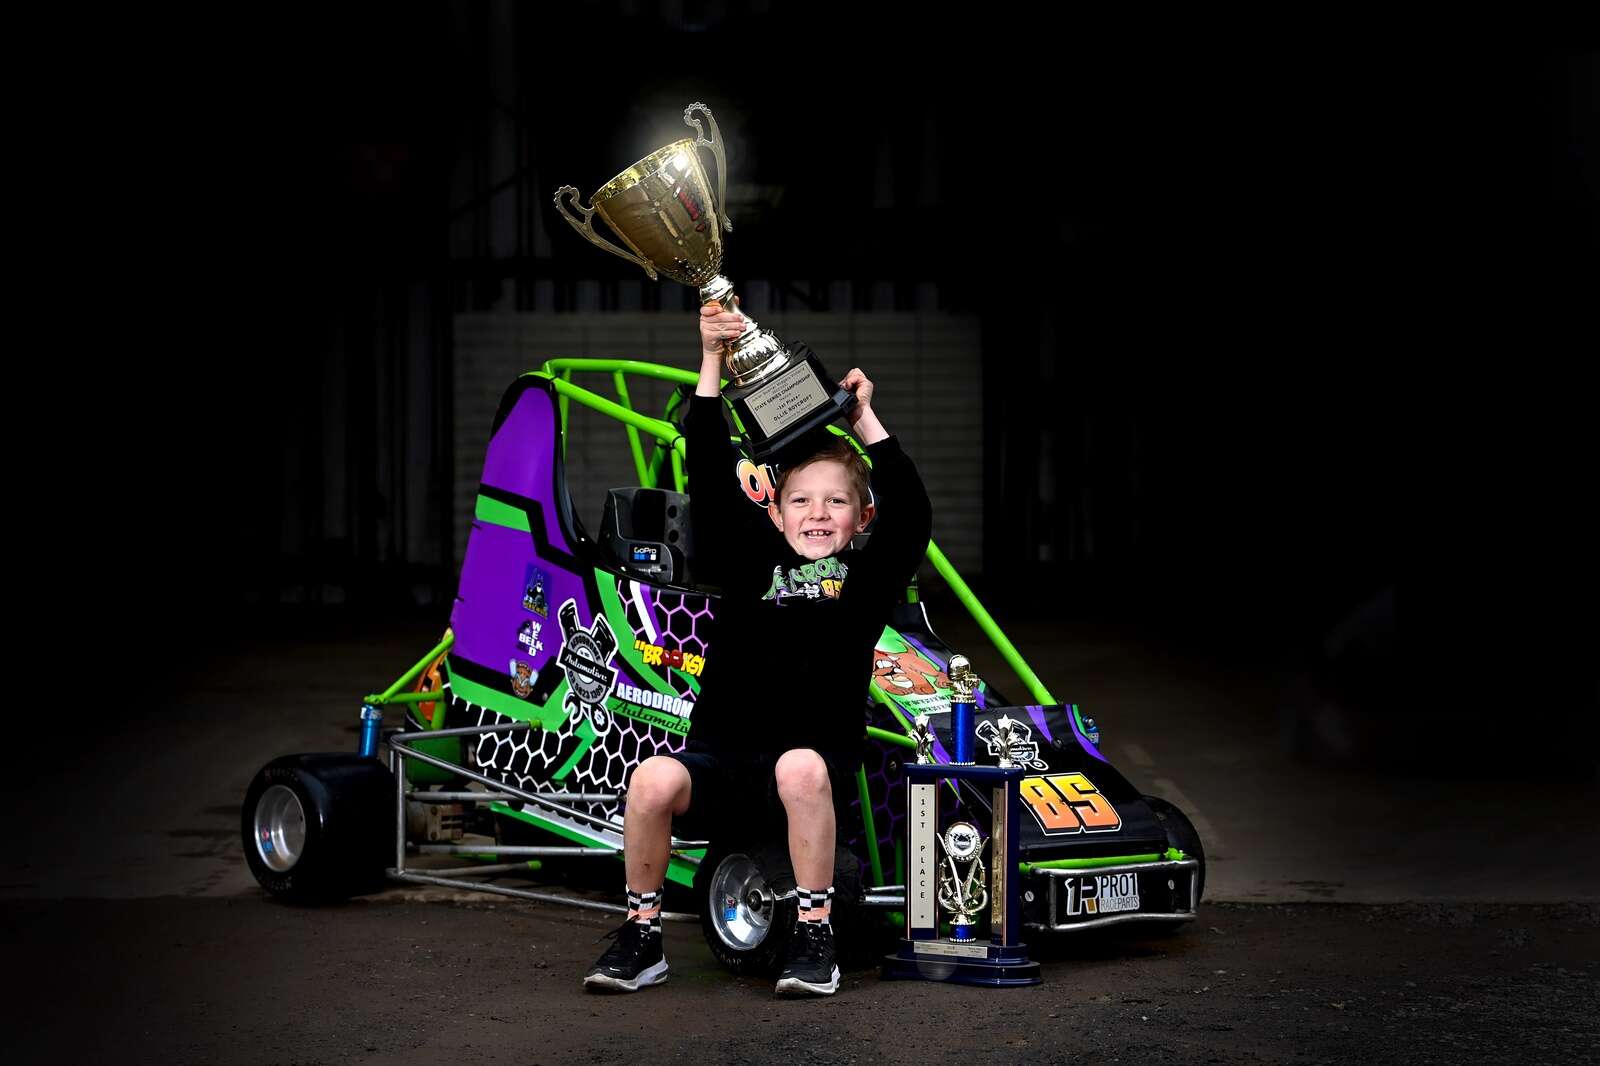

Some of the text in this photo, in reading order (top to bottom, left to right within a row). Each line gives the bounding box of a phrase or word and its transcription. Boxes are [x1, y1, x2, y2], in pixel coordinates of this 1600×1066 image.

[773, 409, 788, 421] OLLIE
[564, 653, 608, 682] Automotive
[616, 683, 695, 719] AERODROM
[1019, 772, 1122, 836] 85
[1099, 874, 1137, 898] PRO1
